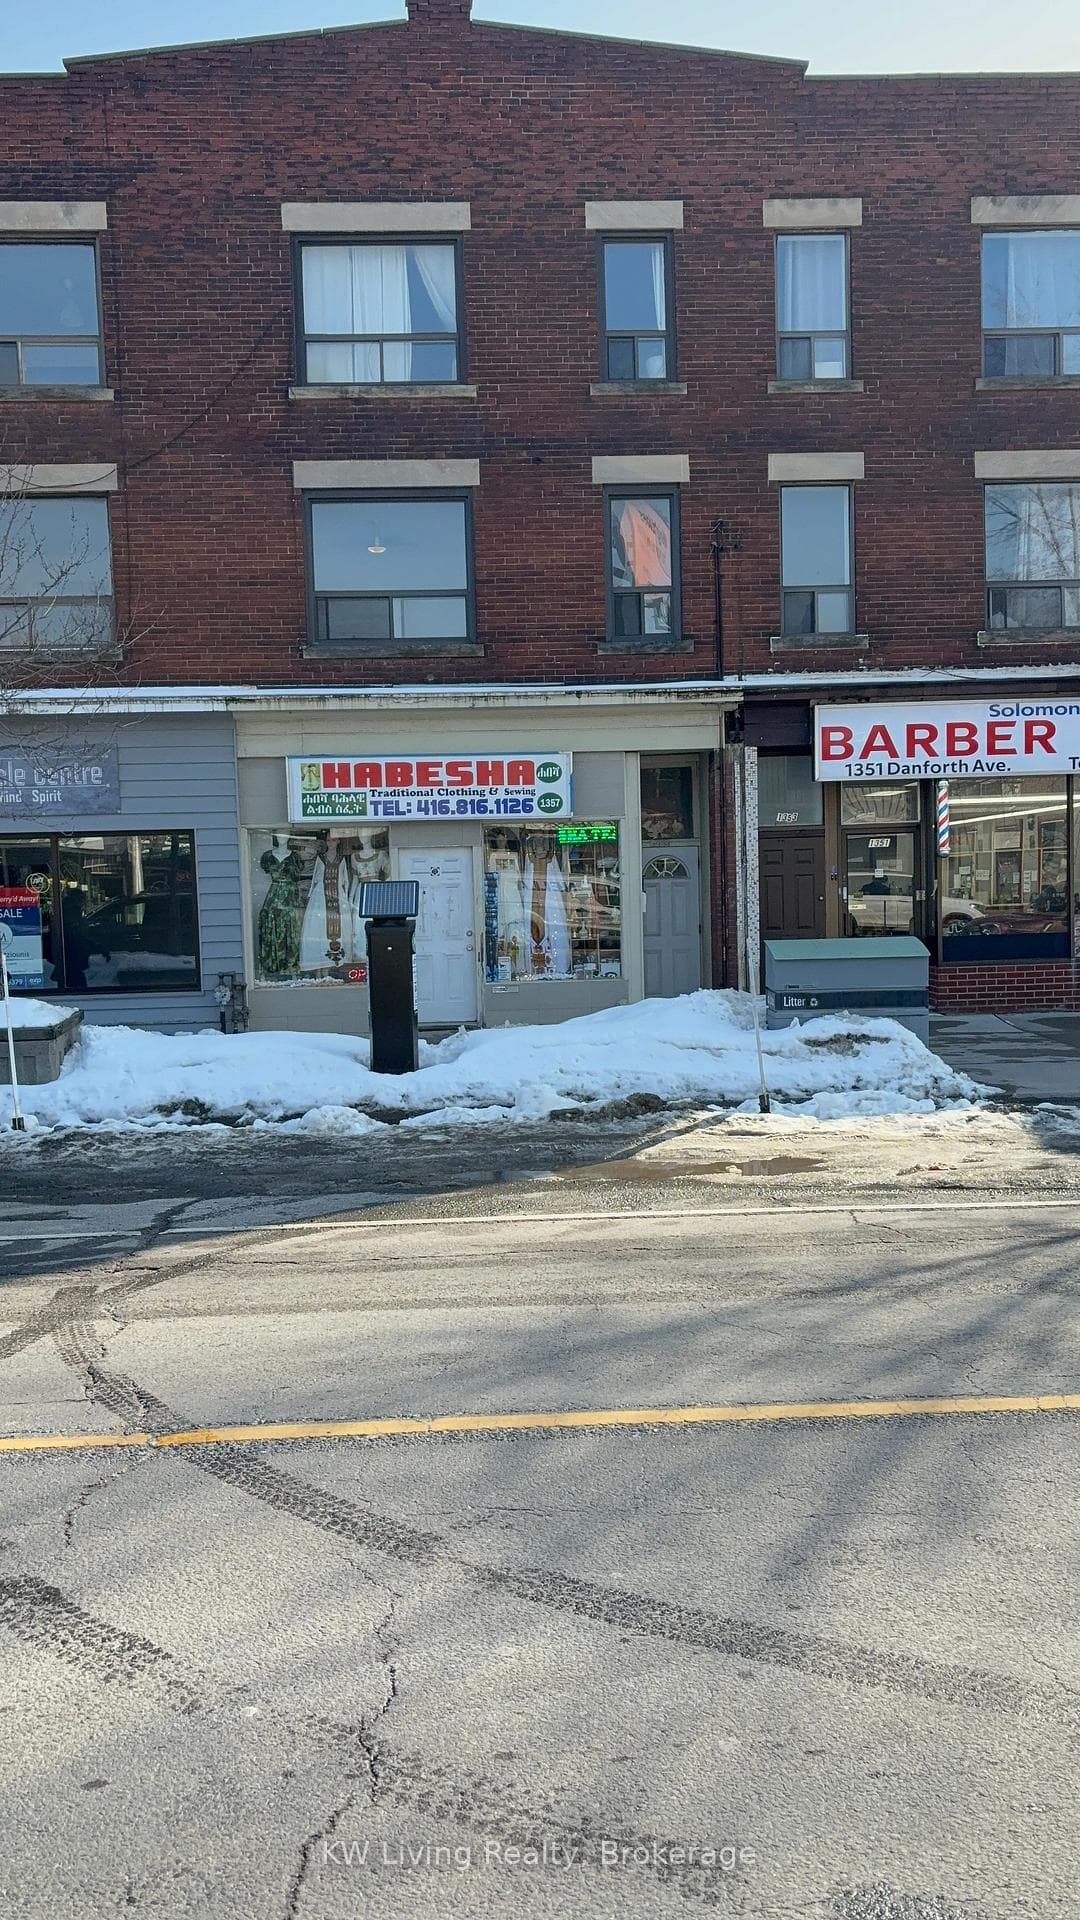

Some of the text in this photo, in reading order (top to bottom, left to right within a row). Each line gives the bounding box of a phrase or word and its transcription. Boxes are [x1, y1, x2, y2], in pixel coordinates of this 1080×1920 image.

[821, 719, 1057, 761] BARBER
[845, 756, 1080, 777] 1351 Danforth Ave. T
[34, 763, 103, 786] centre
[322, 760, 535, 789] HABESHA
[32, 789, 62, 804] Spirit
[369, 787, 536, 798] Traditional Clothing & Sewing
[370, 798, 534, 816] TEL: 416.816.1126
[540, 798, 560, 808] 1357
[776, 813, 798, 823] 1353
[868, 838, 891, 848] 1351
[783, 996, 806, 1007] Litter
